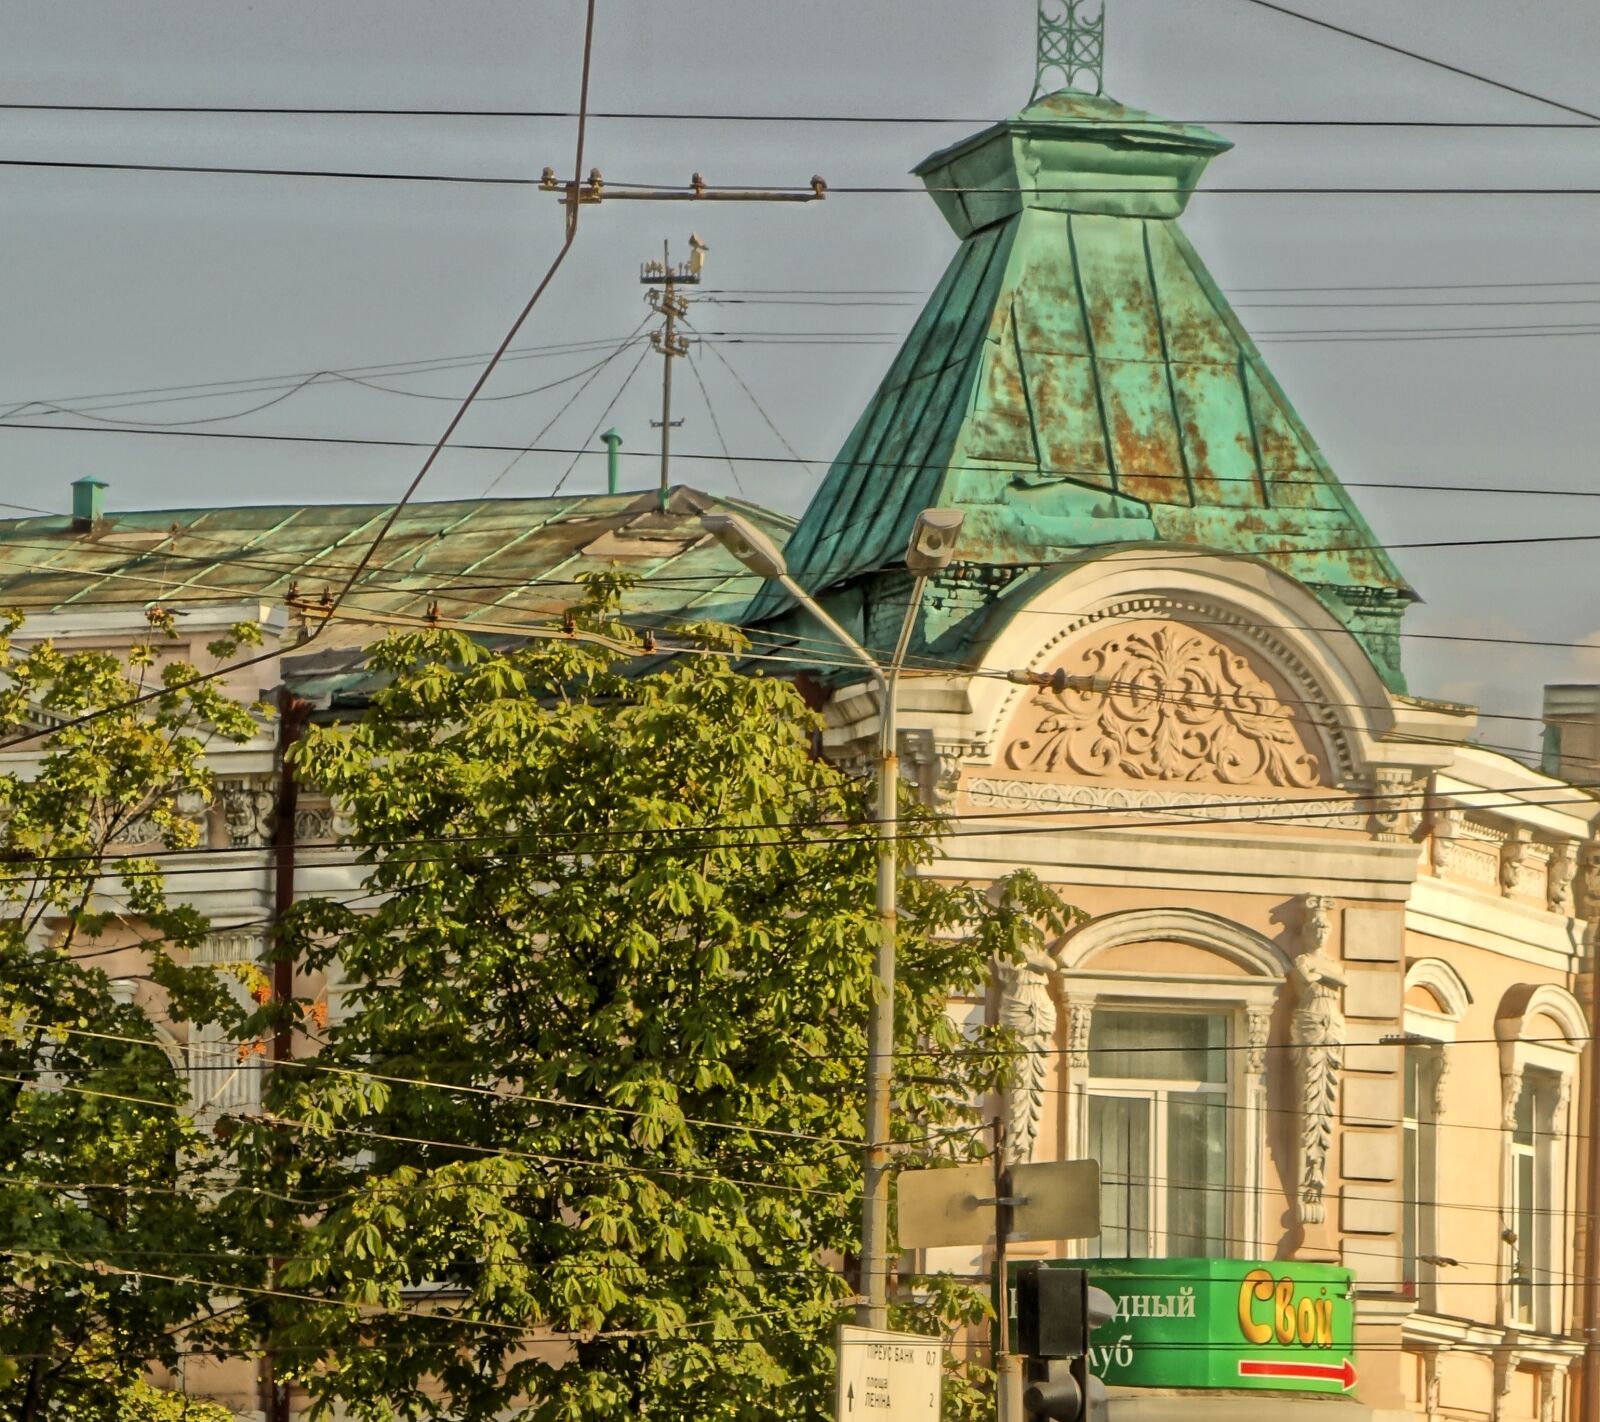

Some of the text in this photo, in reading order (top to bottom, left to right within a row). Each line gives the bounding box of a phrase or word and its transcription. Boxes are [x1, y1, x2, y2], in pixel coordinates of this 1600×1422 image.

[1238, 1268, 1333, 1349] Свой
[894, 1347, 914, 1364] БАНК
[1087, 1334, 1134, 1378] луб
[929, 1393, 934, 1408] 2
